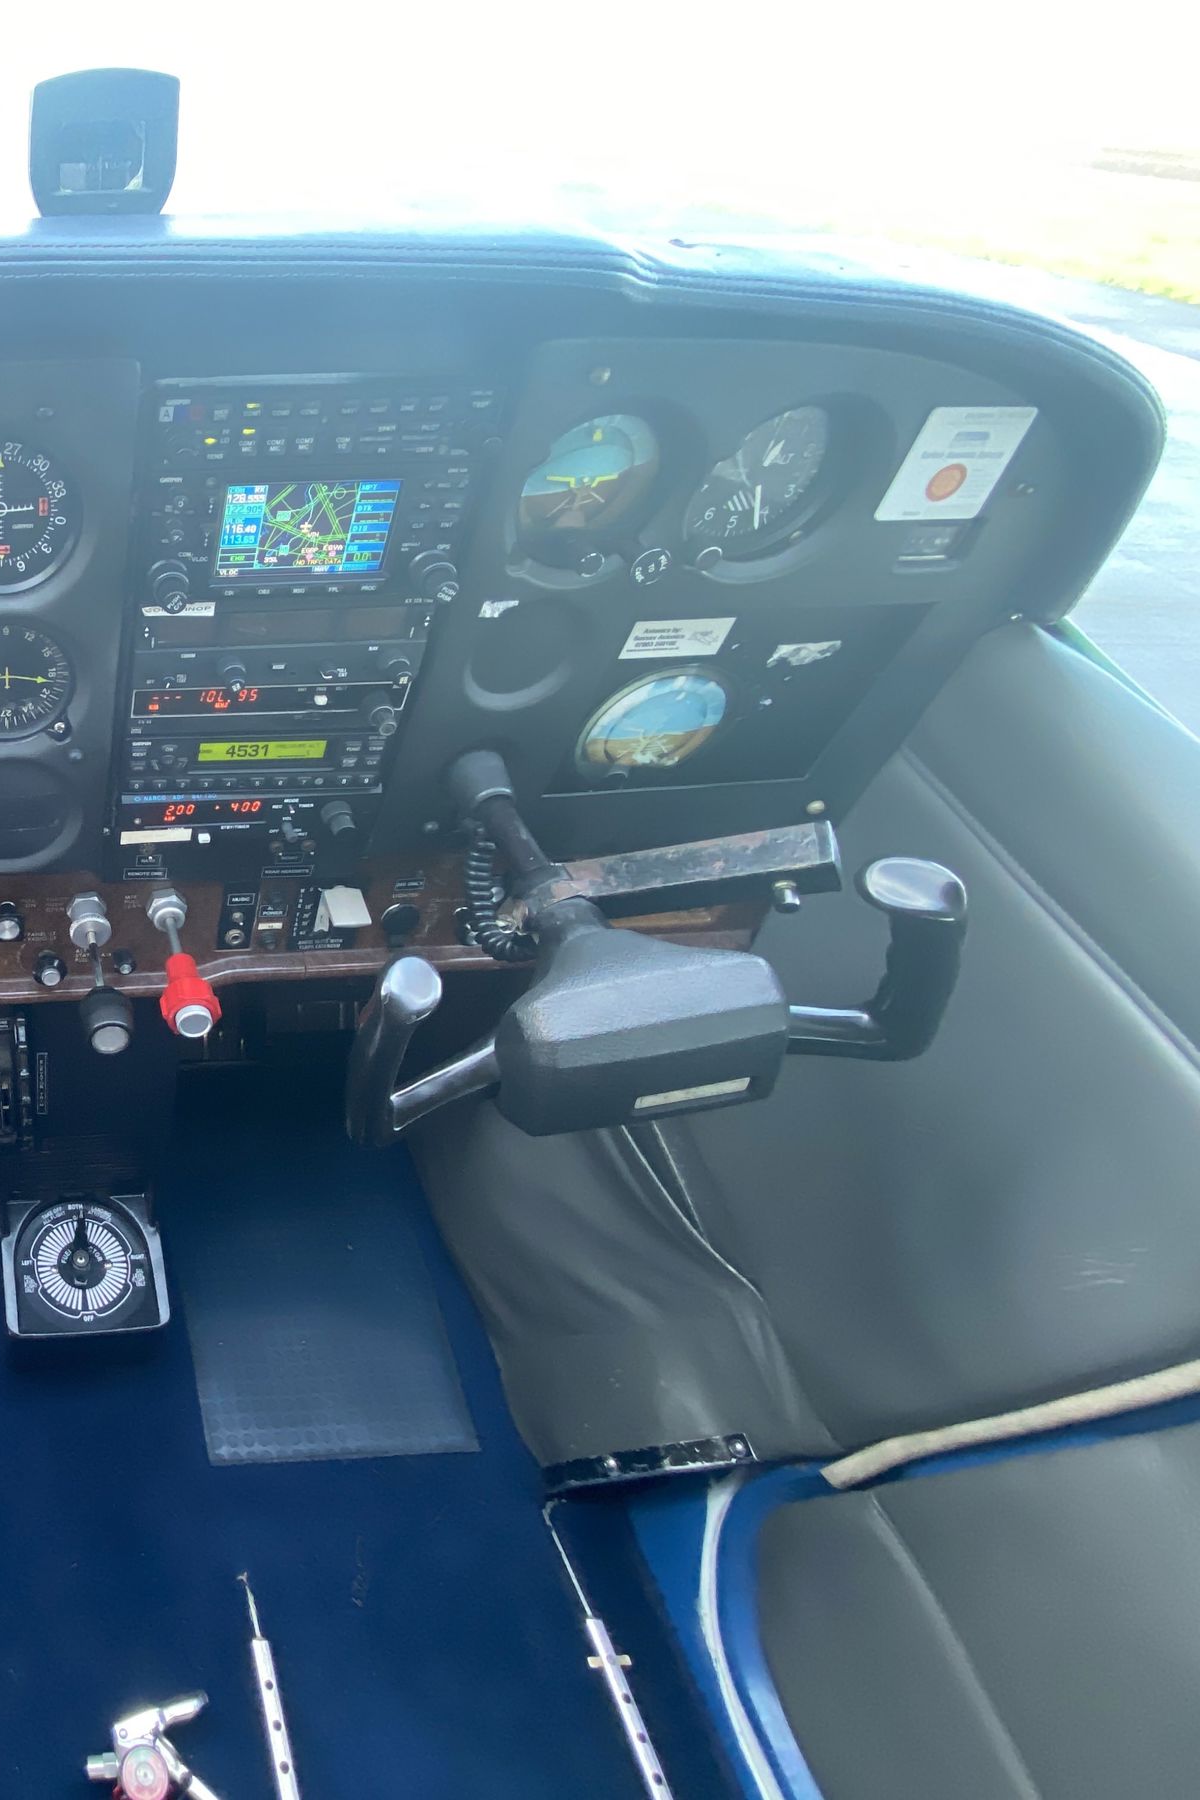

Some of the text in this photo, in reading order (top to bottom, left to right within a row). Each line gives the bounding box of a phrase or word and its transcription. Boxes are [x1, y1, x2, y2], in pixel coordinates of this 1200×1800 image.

[4, 442, 22, 455] 27
[32, 454, 50, 471] 30
[52, 480, 66, 498] 33
[784, 484, 796, 498] 3
[704, 507, 716, 520] 6
[727, 515, 738, 528] 5
[225, 525, 257, 534] 116.40
[296, 558, 307, 566] NO
[185, 604, 212, 612] INOP
[23, 631, 35, 641] 12
[47, 667, 57, 678] 18
[225, 743, 269, 758] 4531
[165, 803, 196, 816] 200
[231, 801, 261, 812] 400
[52, 1206, 62, 1214] OFF
